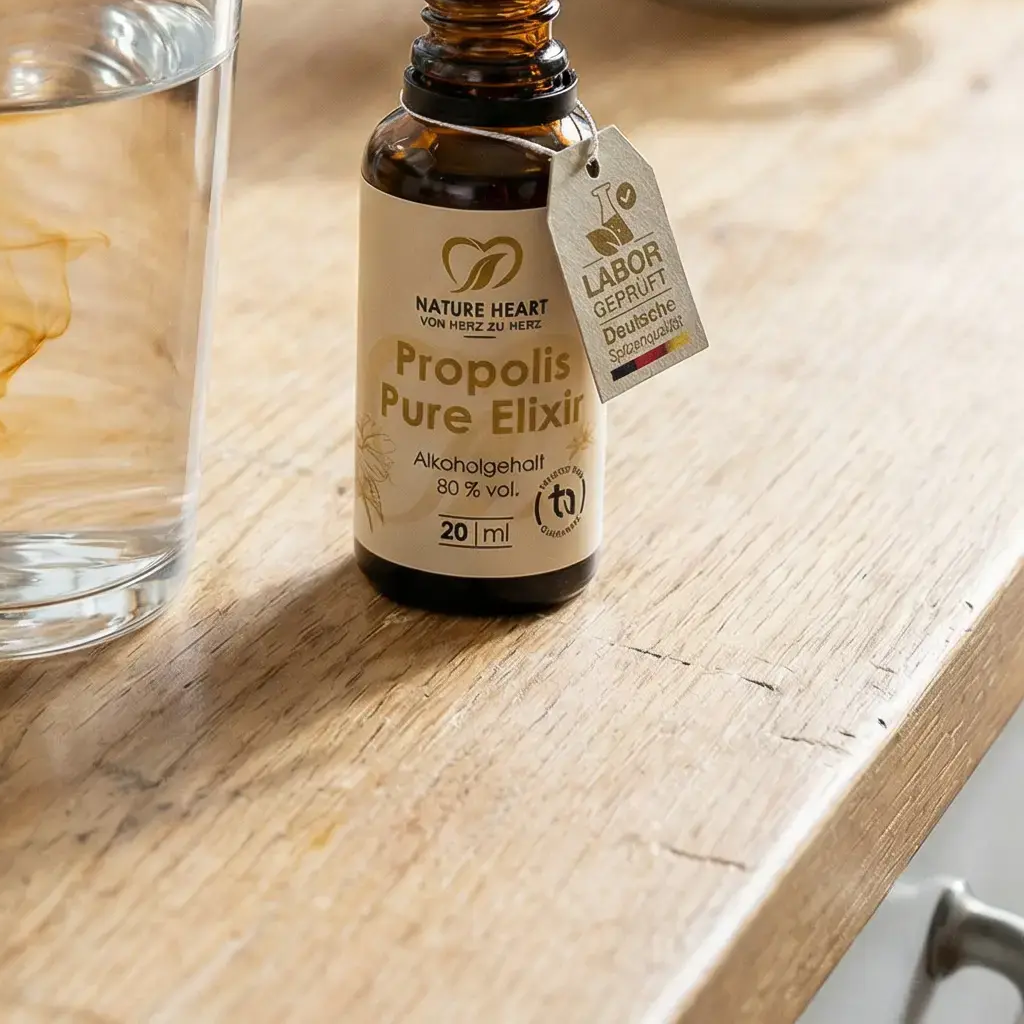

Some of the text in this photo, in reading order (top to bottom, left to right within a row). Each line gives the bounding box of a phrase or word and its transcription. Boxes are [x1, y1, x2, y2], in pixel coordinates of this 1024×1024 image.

[582, 240, 663, 298] LABOR
[416, 295, 549, 318] NATURE HEART
[593, 268, 666, 318] GEPRÜFT
[420, 315, 446, 329] VON
[487, 322, 504, 332] ZU
[509, 320, 542, 331] HERZ
[602, 299, 677, 345] Deutsche
[396, 340, 571, 396] Propolis
[381, 382, 584, 435] Pure Elixir
[413, 451, 545, 478] Alkoholgehalt
[436, 479, 520, 498] 80 % vol.
[439, 521, 509, 543] 20 ml
